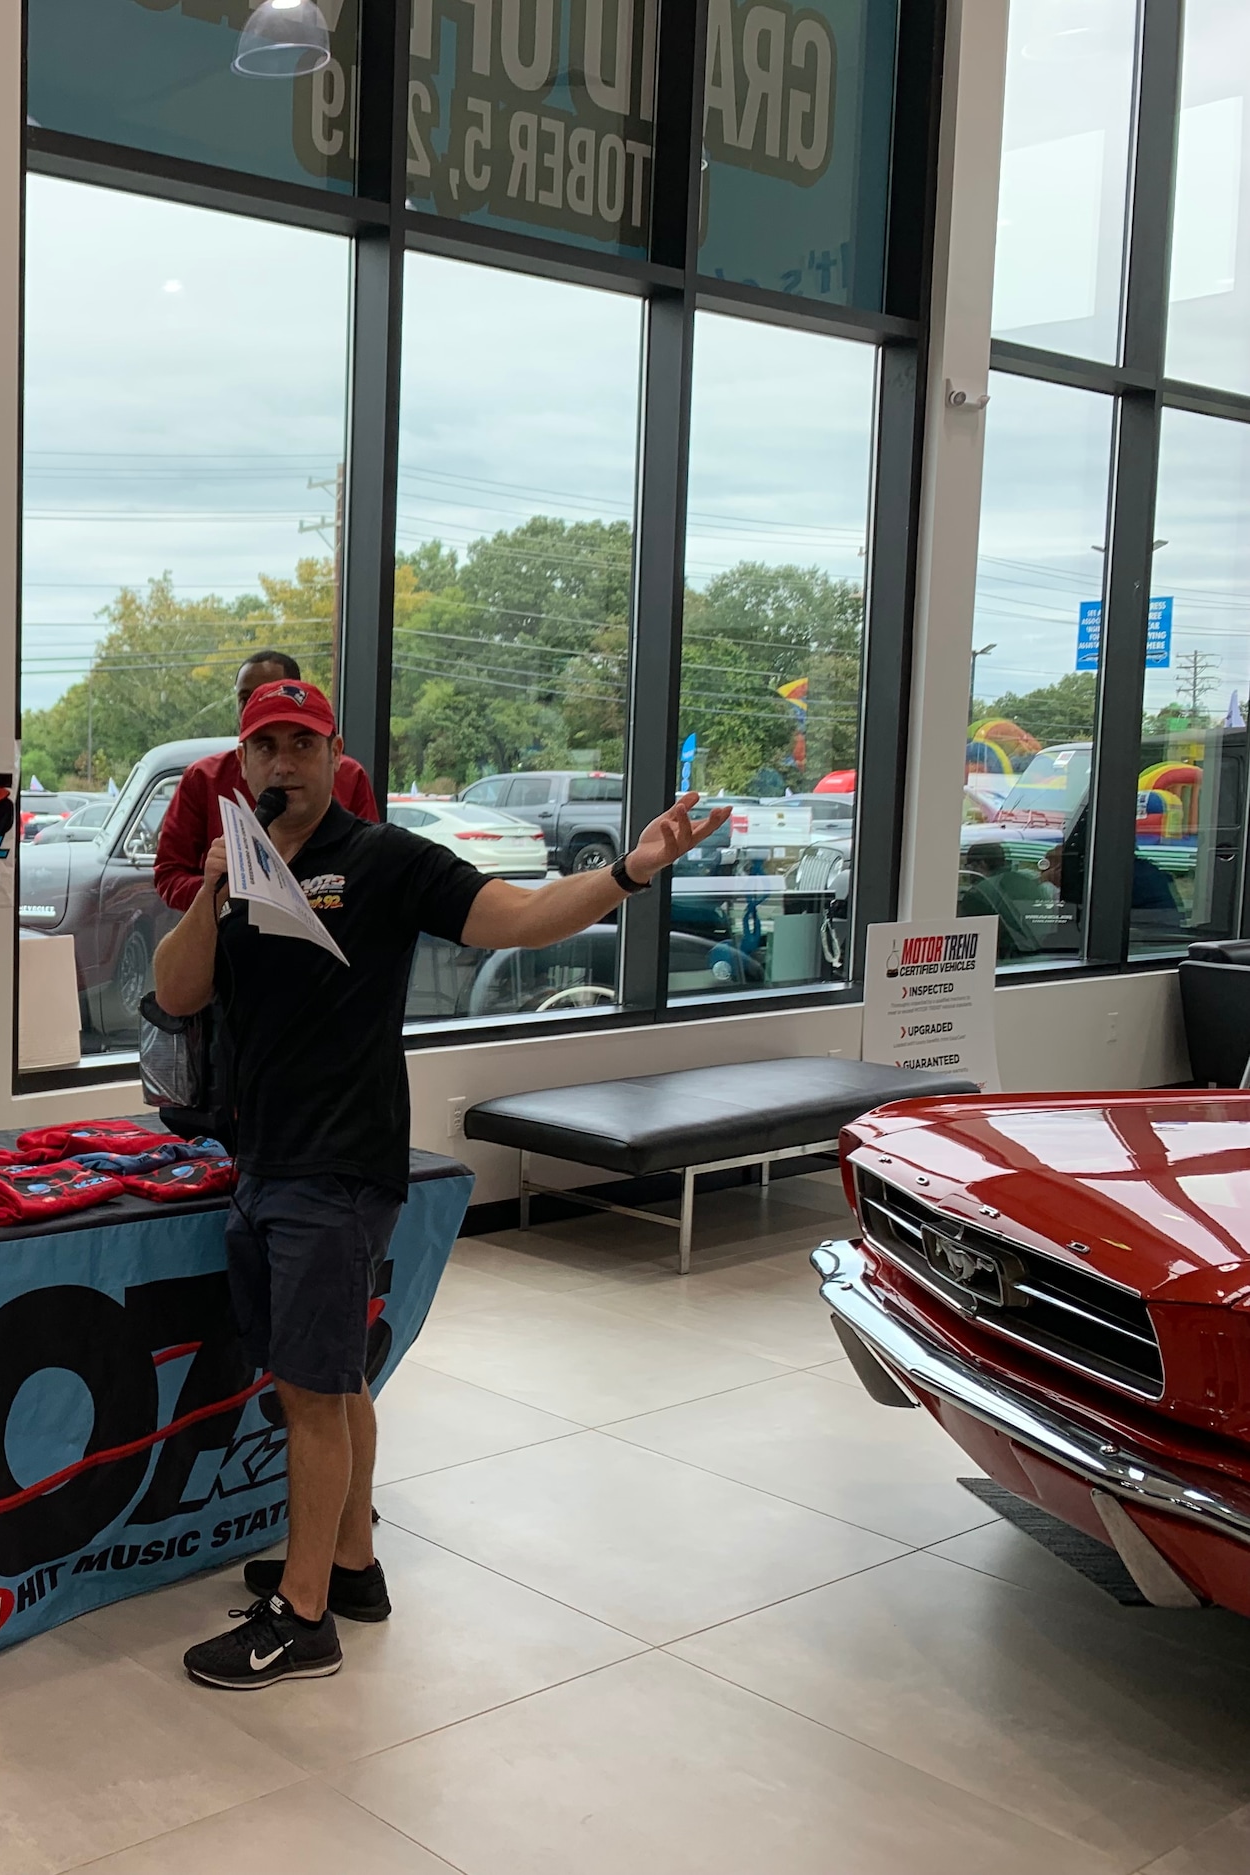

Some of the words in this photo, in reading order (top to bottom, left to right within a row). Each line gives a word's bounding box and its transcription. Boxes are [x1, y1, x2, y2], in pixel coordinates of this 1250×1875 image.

[900, 962, 939, 977] CERTIFIED
[940, 960, 976, 974] VEHICLES
[909, 982, 954, 997] INSPECTED
[907, 1021, 953, 1037] UPGRADED
[903, 1053, 960, 1070] GUARANTEED
[16, 1562, 68, 1614] HIT
[71, 1530, 202, 1576] MUSIC
[210, 1499, 288, 1549] STAT
